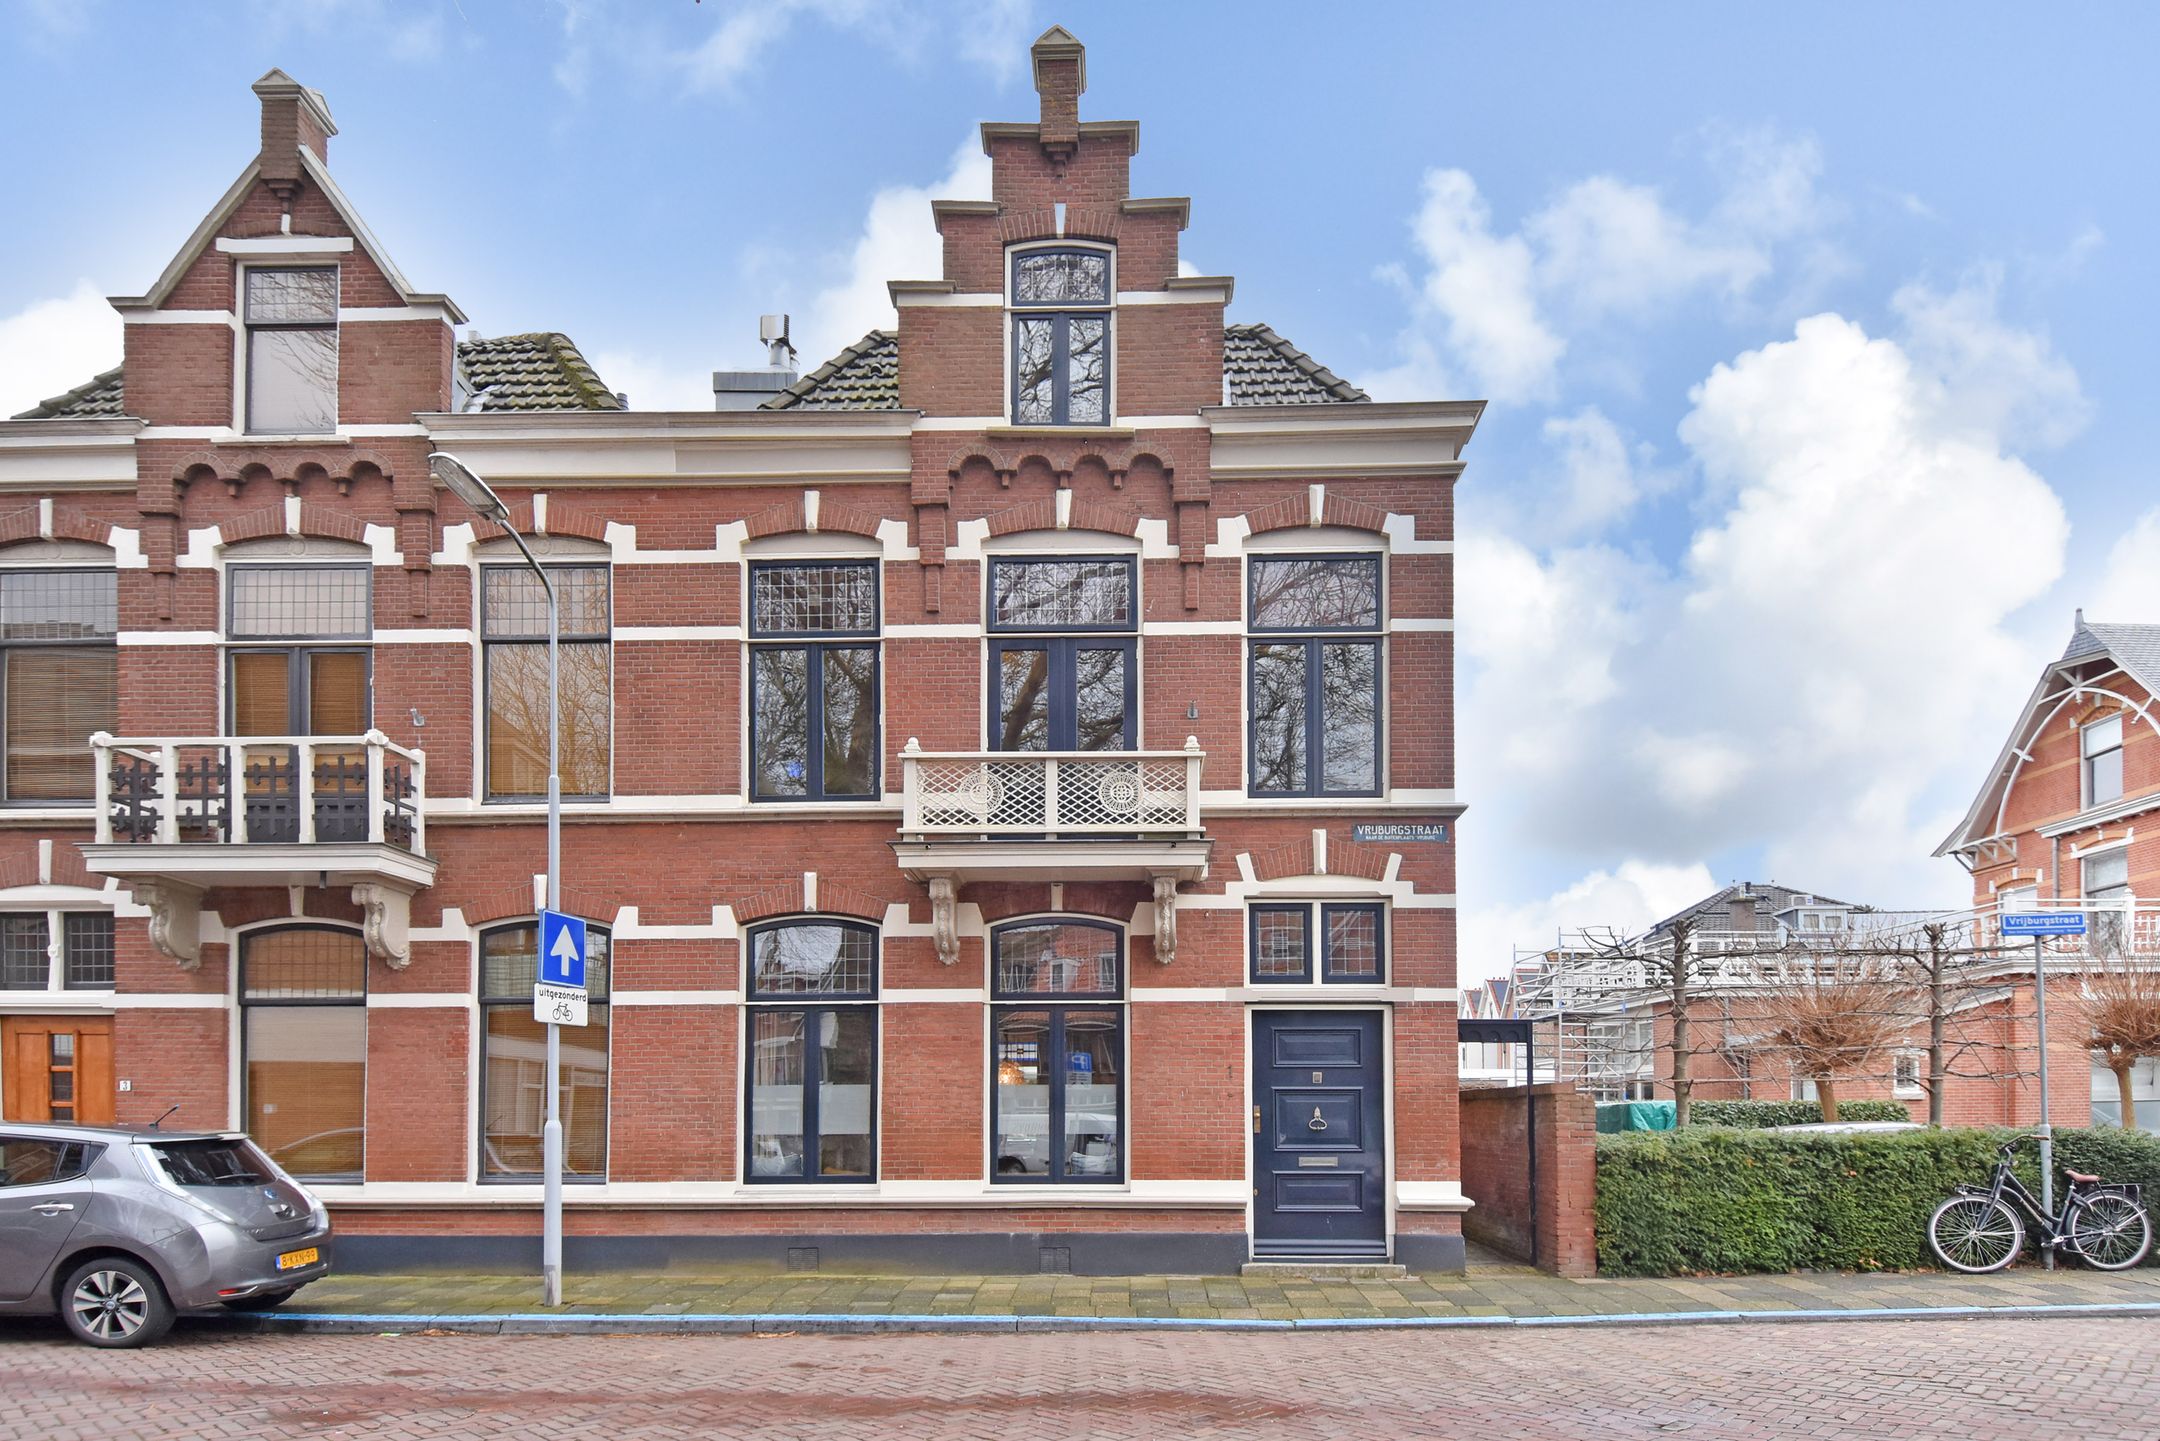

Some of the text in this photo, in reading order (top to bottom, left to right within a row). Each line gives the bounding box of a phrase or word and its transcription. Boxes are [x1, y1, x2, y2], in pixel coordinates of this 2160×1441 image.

[1357, 825, 1444, 835] VRIJBURGSTRAAT
[2008, 916, 2080, 927] Vrijburgstraat
[538, 988, 587, 1002] uitgezonderd
